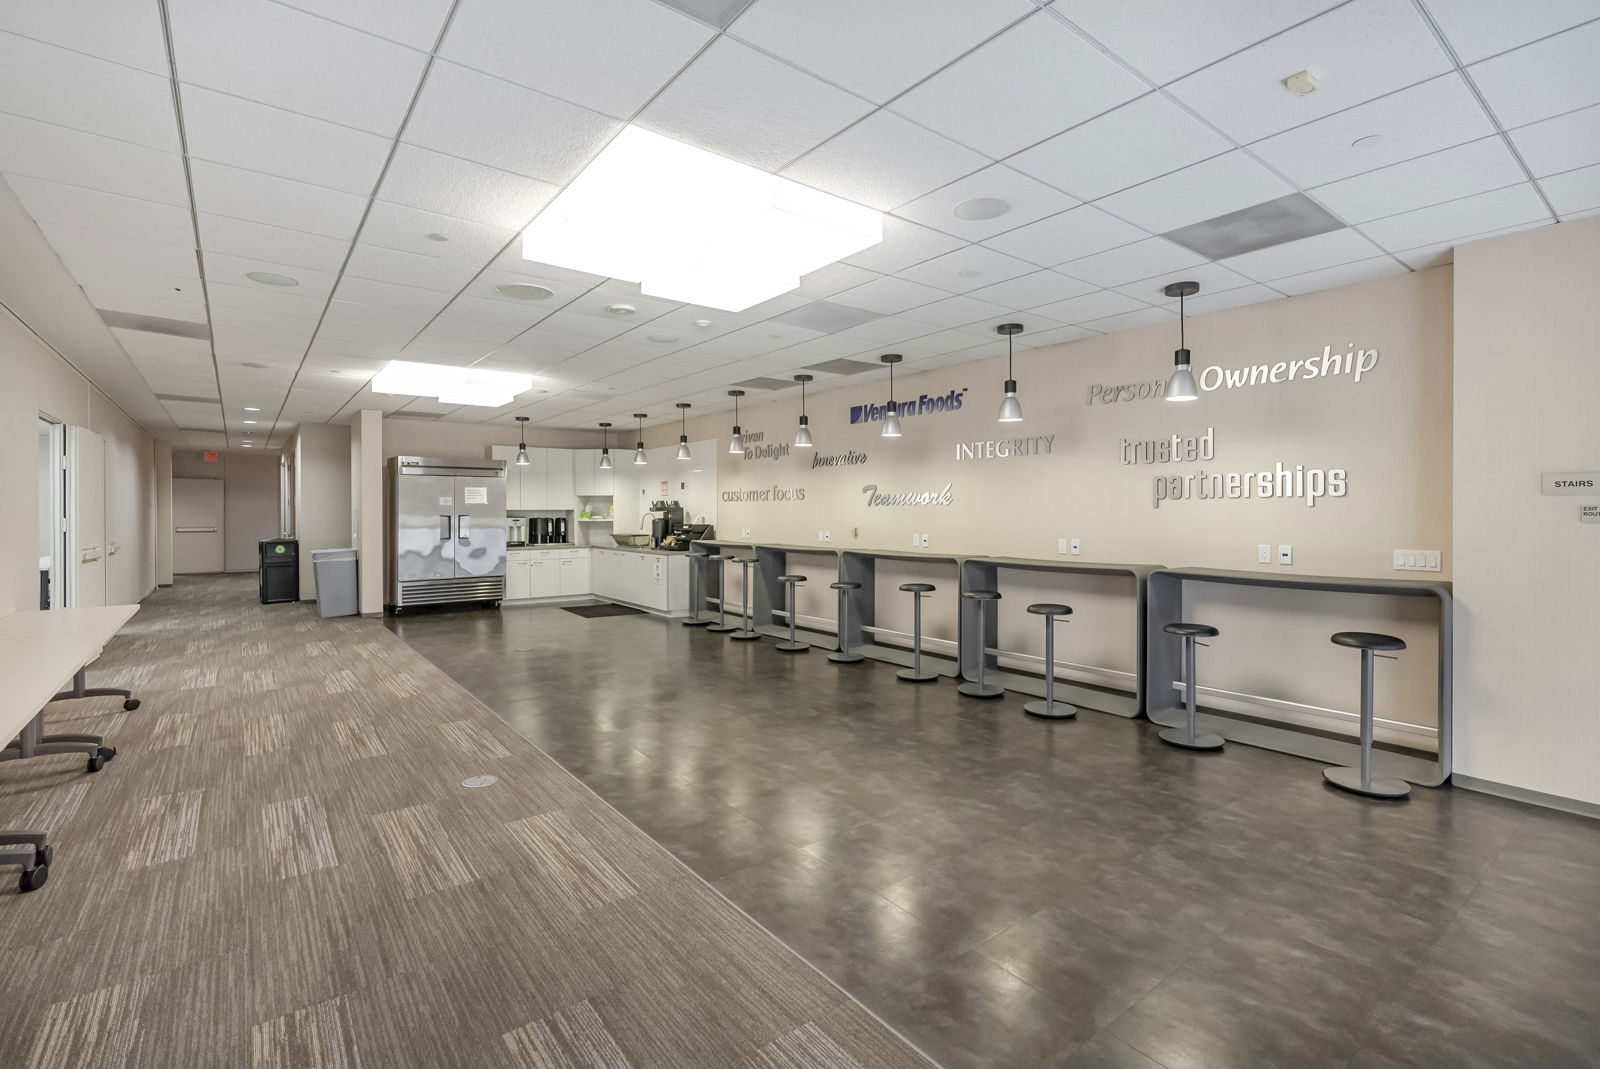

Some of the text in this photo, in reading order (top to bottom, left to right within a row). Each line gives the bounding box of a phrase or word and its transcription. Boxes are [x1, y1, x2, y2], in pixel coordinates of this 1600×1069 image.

[1086, 342, 1379, 406] Person Ownership
[863, 403, 917, 423] Venura
[741, 430, 764, 444] riven
[1119, 426, 1215, 466] trusted
[743, 442, 790, 461] To Delight
[956, 434, 1056, 461] INTEGRITY
[811, 450, 867, 470] Innovative
[722, 485, 806, 502] customer focus
[1152, 462, 1348, 509] partnerships
[1554, 480, 1594, 488] STAIRS
[862, 482, 954, 508] Teamwork
